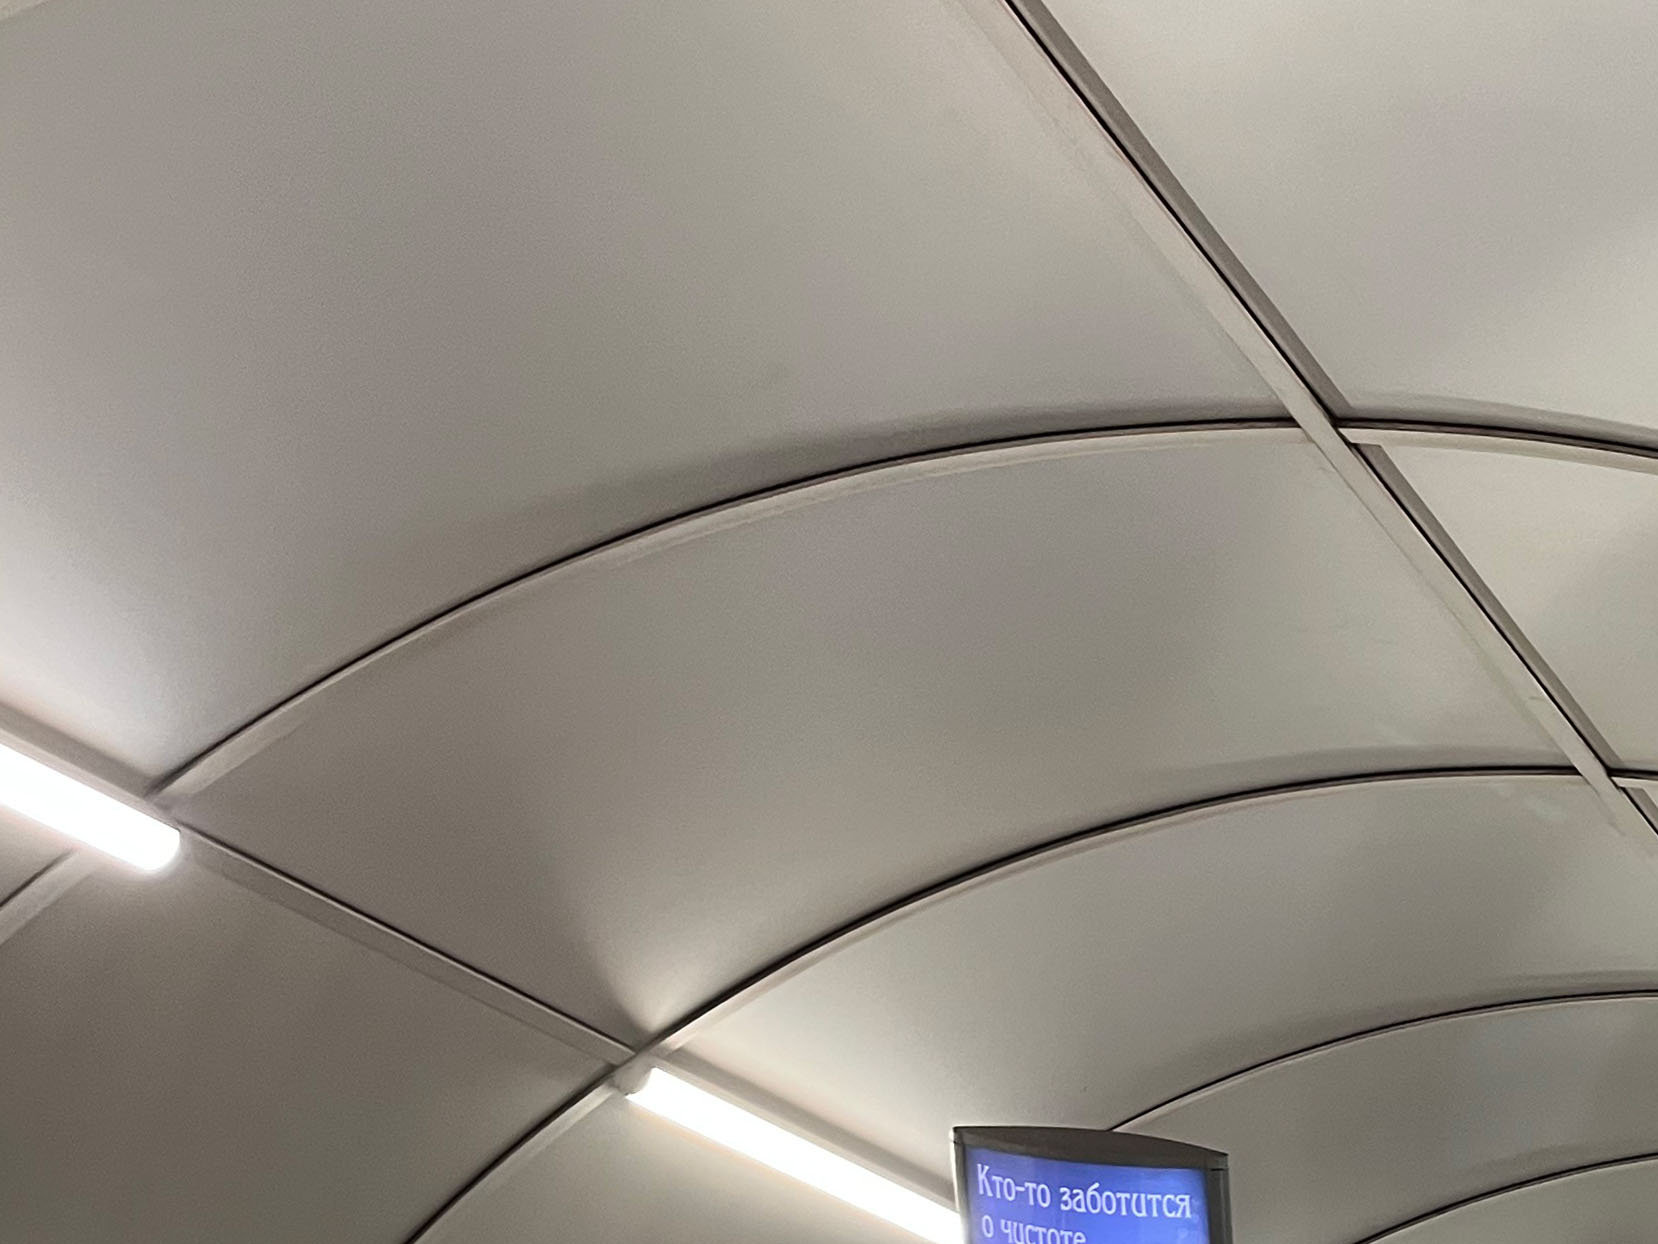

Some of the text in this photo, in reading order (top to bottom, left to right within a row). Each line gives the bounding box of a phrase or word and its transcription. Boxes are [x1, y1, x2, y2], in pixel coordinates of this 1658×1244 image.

[977, 1163, 1192, 1219] Кто-то заботится
[982, 1215, 994, 1238] о
